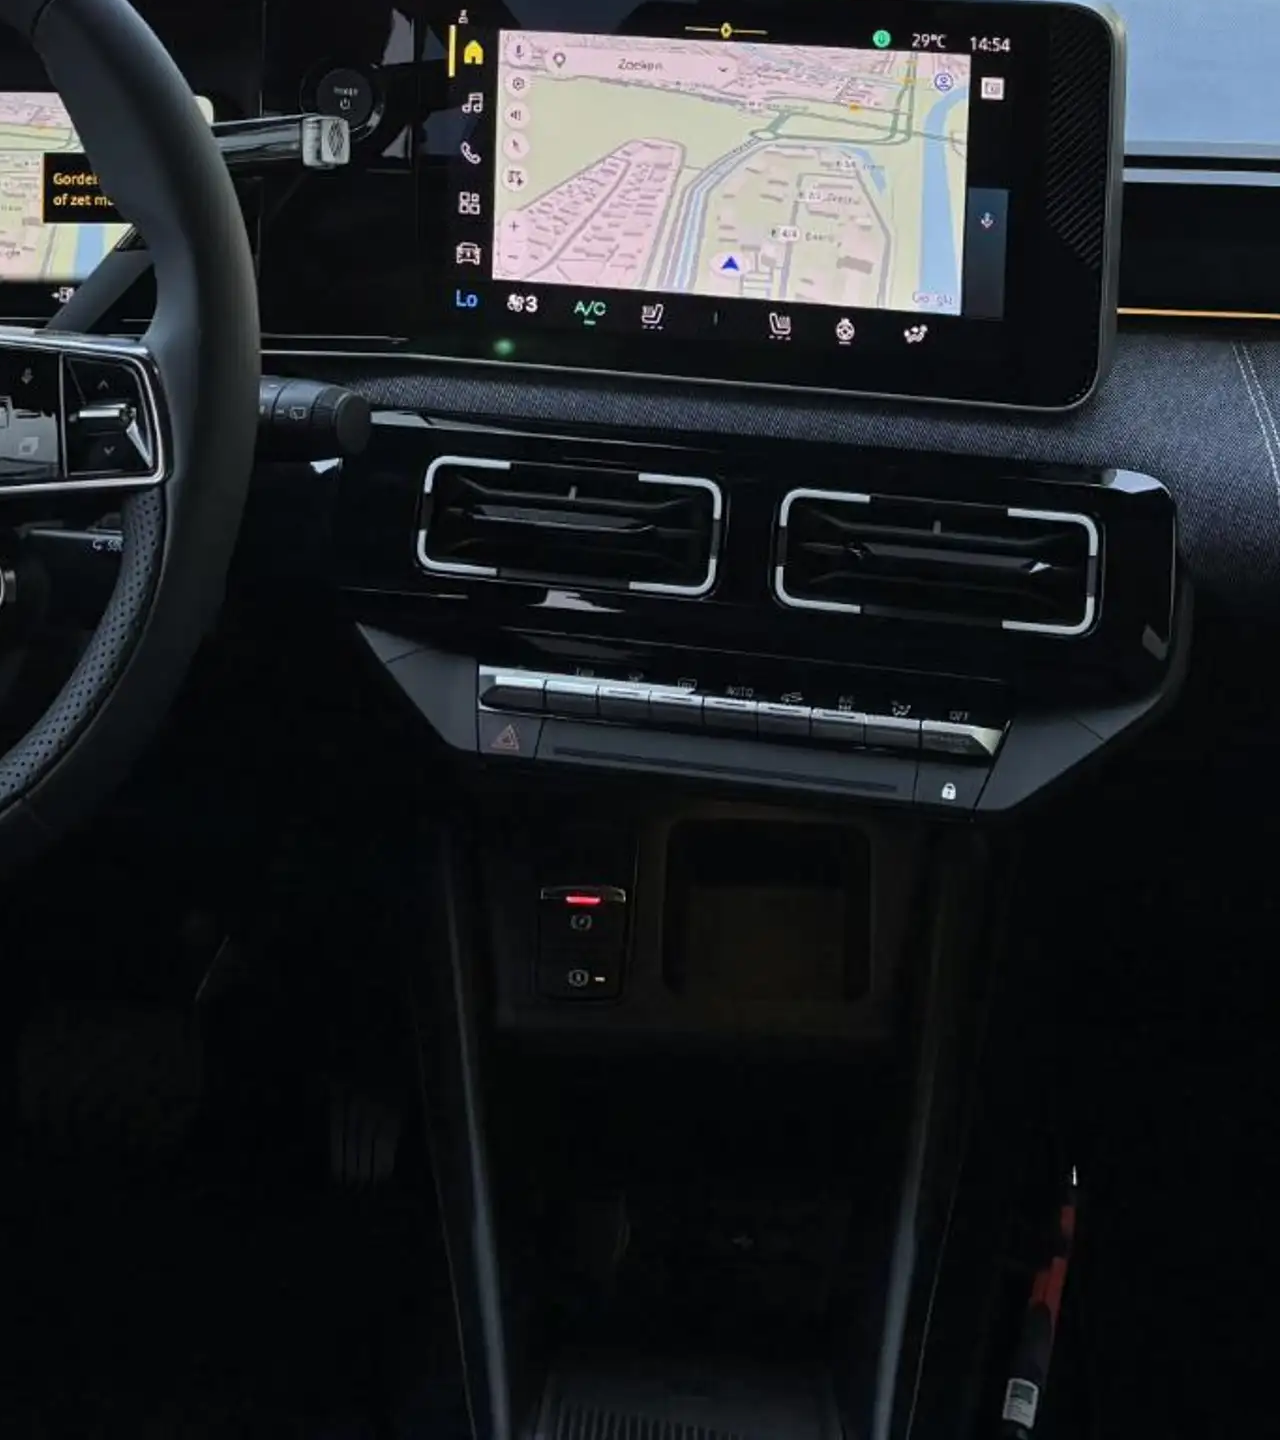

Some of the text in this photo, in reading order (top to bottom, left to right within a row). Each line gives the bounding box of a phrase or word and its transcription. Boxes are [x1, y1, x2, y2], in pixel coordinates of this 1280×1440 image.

[970, 35, 1011, 53] 14:54
[52, 192, 68, 206] of
[70, 194, 91, 206] zet
[455, 288, 479, 308] Lo
[525, 295, 539, 313] 3
[574, 299, 607, 317] A/C
[726, 686, 754, 698] AUTO
